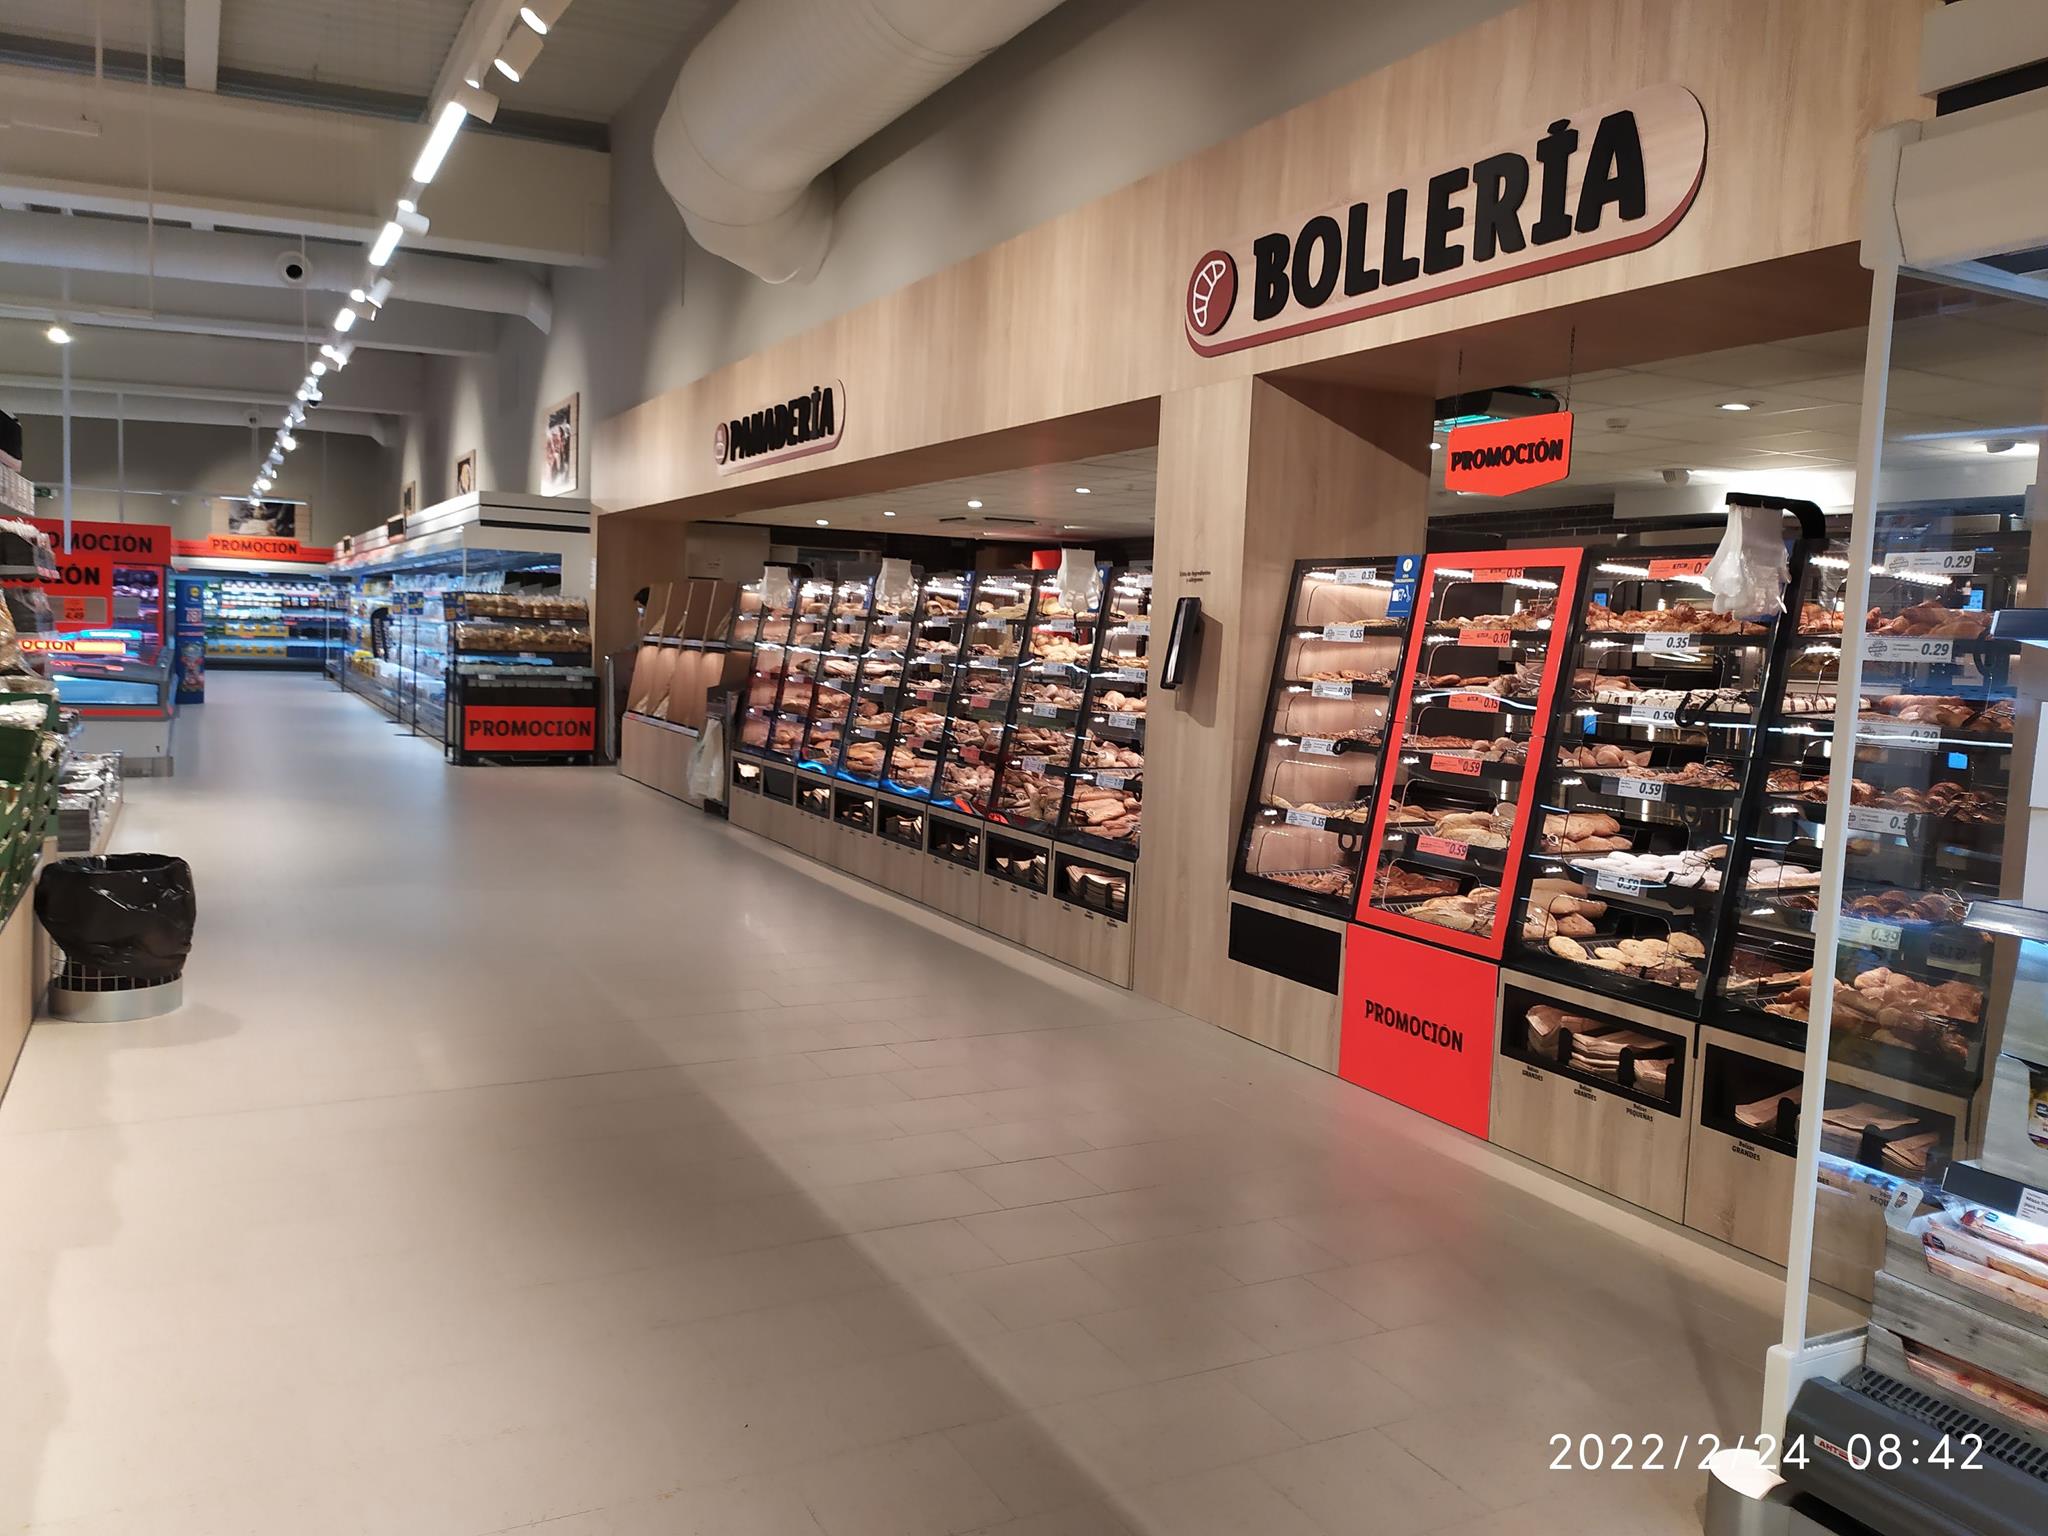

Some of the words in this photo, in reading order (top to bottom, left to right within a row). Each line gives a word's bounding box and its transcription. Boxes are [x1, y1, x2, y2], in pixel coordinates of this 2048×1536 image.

[1253, 109, 1646, 322] BOLLERÍA
[730, 386, 834, 461] PANADERÍA
[1451, 437, 1563, 472] PROMOCIÓN
[1943, 555, 1973, 569] 0.29
[1492, 632, 1509, 644] 0.10
[1666, 636, 1689, 648] 0.35
[1921, 643, 1950, 656] 0.29
[1462, 760, 1480, 773] 0.59
[1639, 782, 1662, 796] 0.59
[1449, 843, 1467, 857] 0.59
